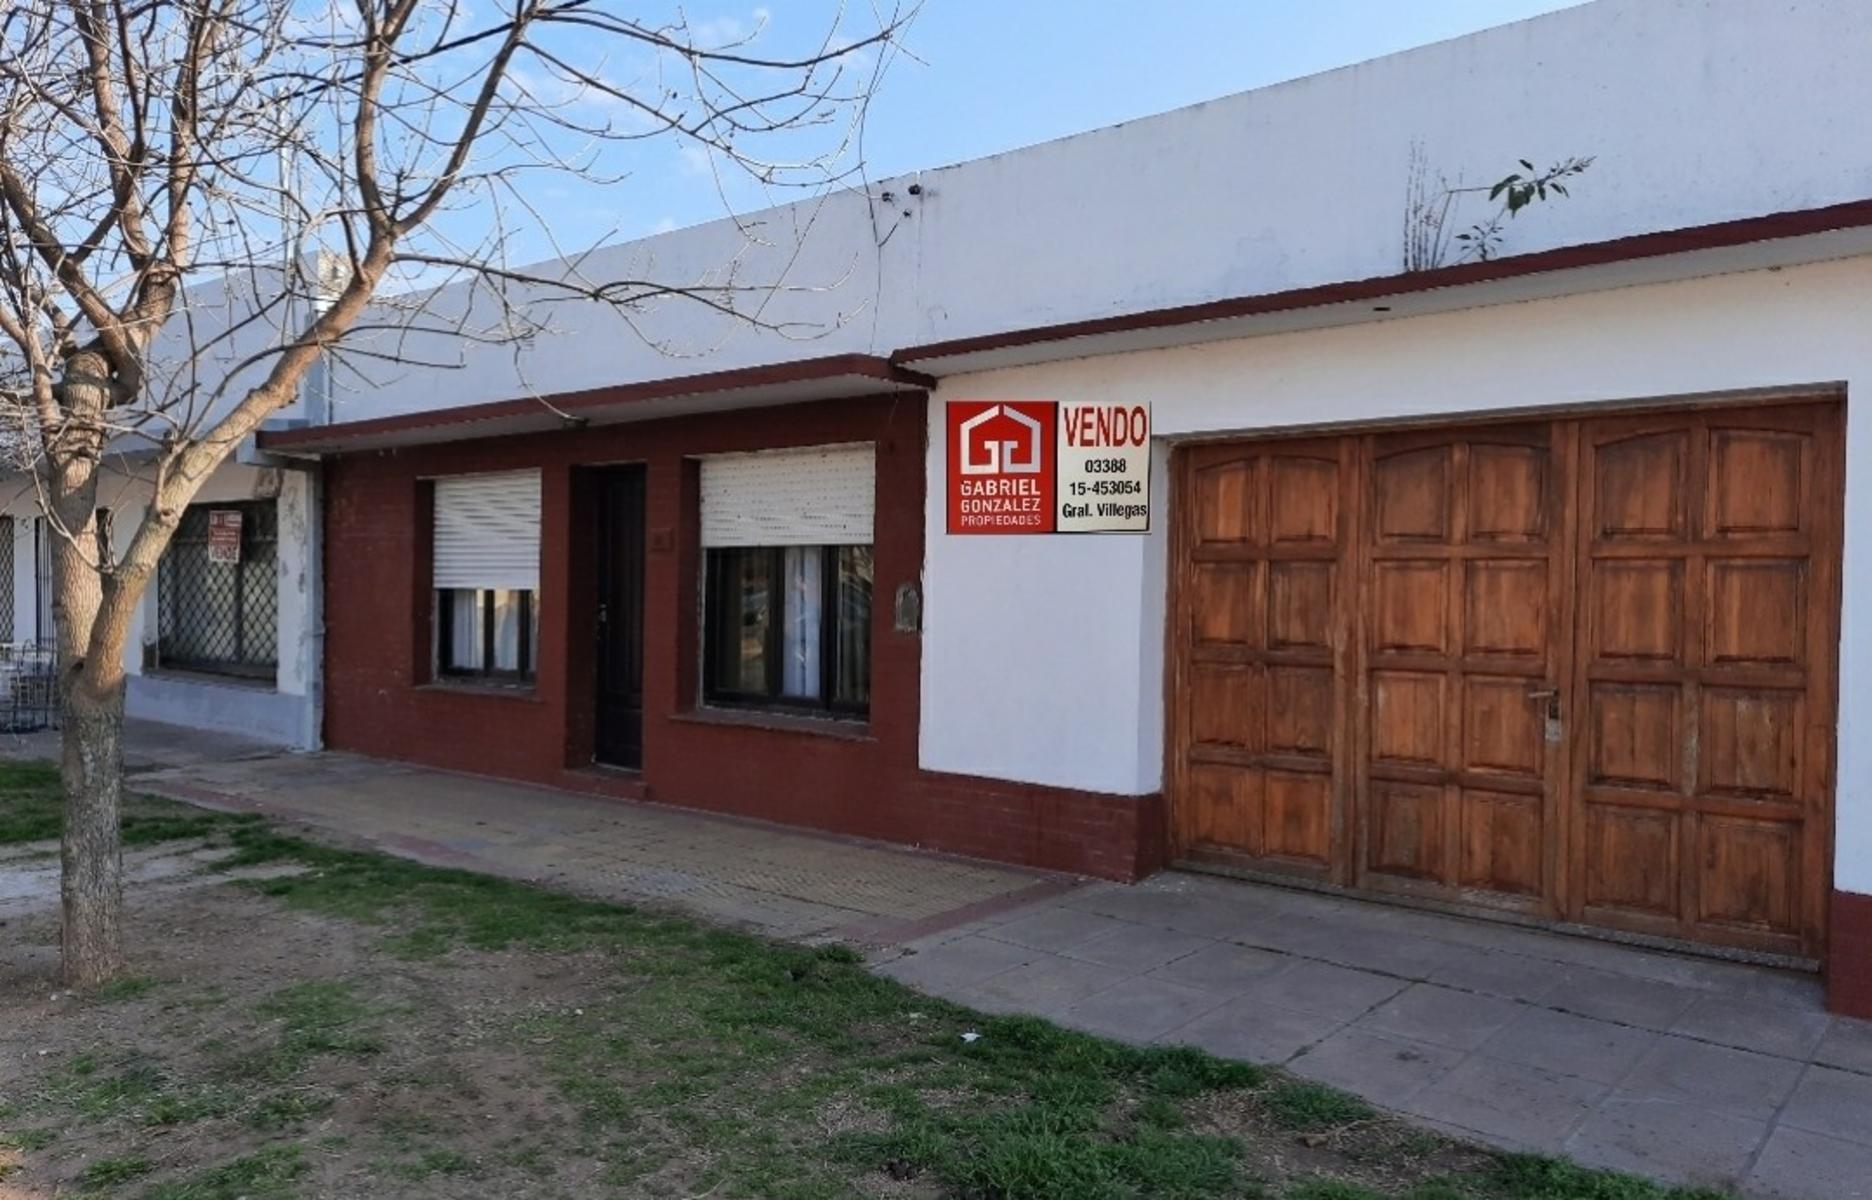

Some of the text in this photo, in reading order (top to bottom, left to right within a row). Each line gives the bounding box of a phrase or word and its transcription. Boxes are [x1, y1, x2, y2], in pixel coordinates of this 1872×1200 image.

[1064, 406, 1147, 448] VENDO
[1085, 458, 1126, 474] 03388
[961, 479, 1041, 496] GABRIEL
[1069, 481, 1142, 496] 15-453054
[961, 498, 1041, 513] GONZALEZ
[1063, 503, 1147, 520] Gral. Villegas
[961, 514, 1041, 527] PROPIEDADES
